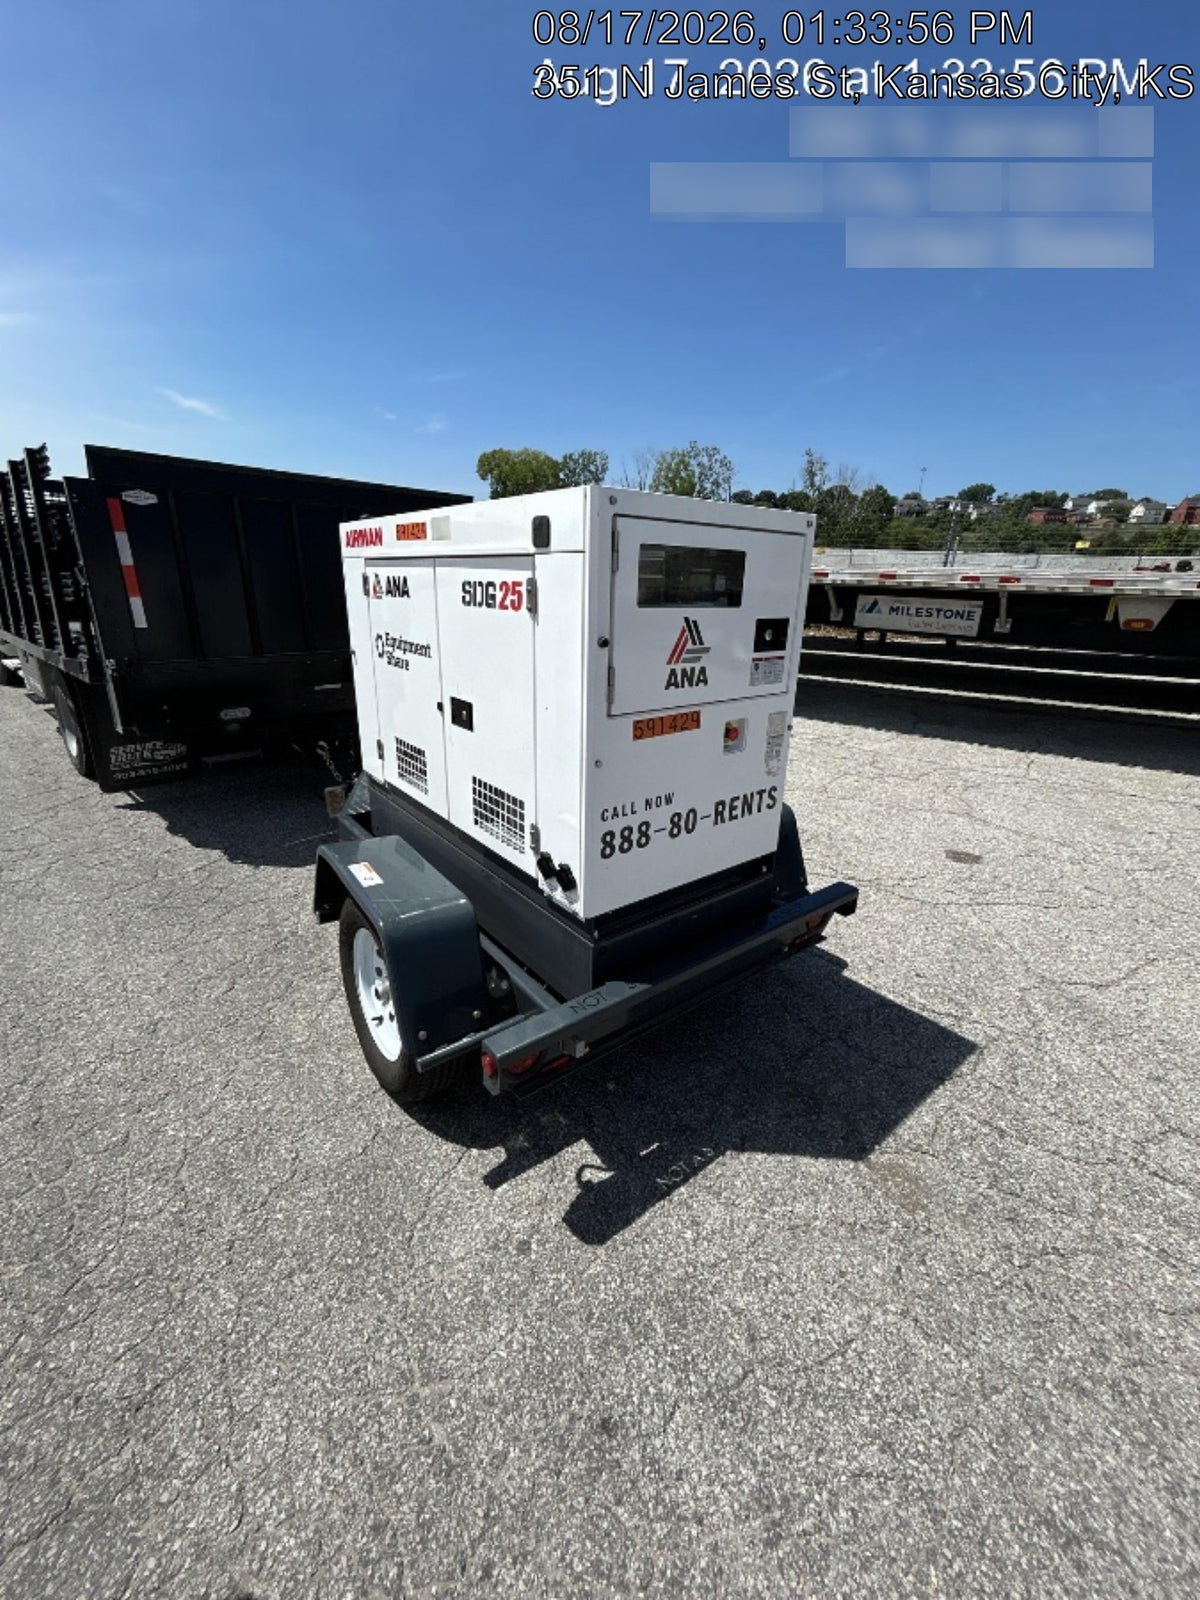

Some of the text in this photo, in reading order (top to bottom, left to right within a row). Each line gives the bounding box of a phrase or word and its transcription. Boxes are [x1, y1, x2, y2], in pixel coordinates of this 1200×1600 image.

[385, 576, 411, 598] ANA
[888, 605, 977, 621] MILESTONE
[385, 632, 432, 658] Equipment
[386, 650, 410, 671] Share
[664, 666, 709, 690] ANA
[633, 710, 701, 740] 591429
[601, 792, 675, 822] CALL NOW
[600, 785, 778, 859] 888-80-RENTS
